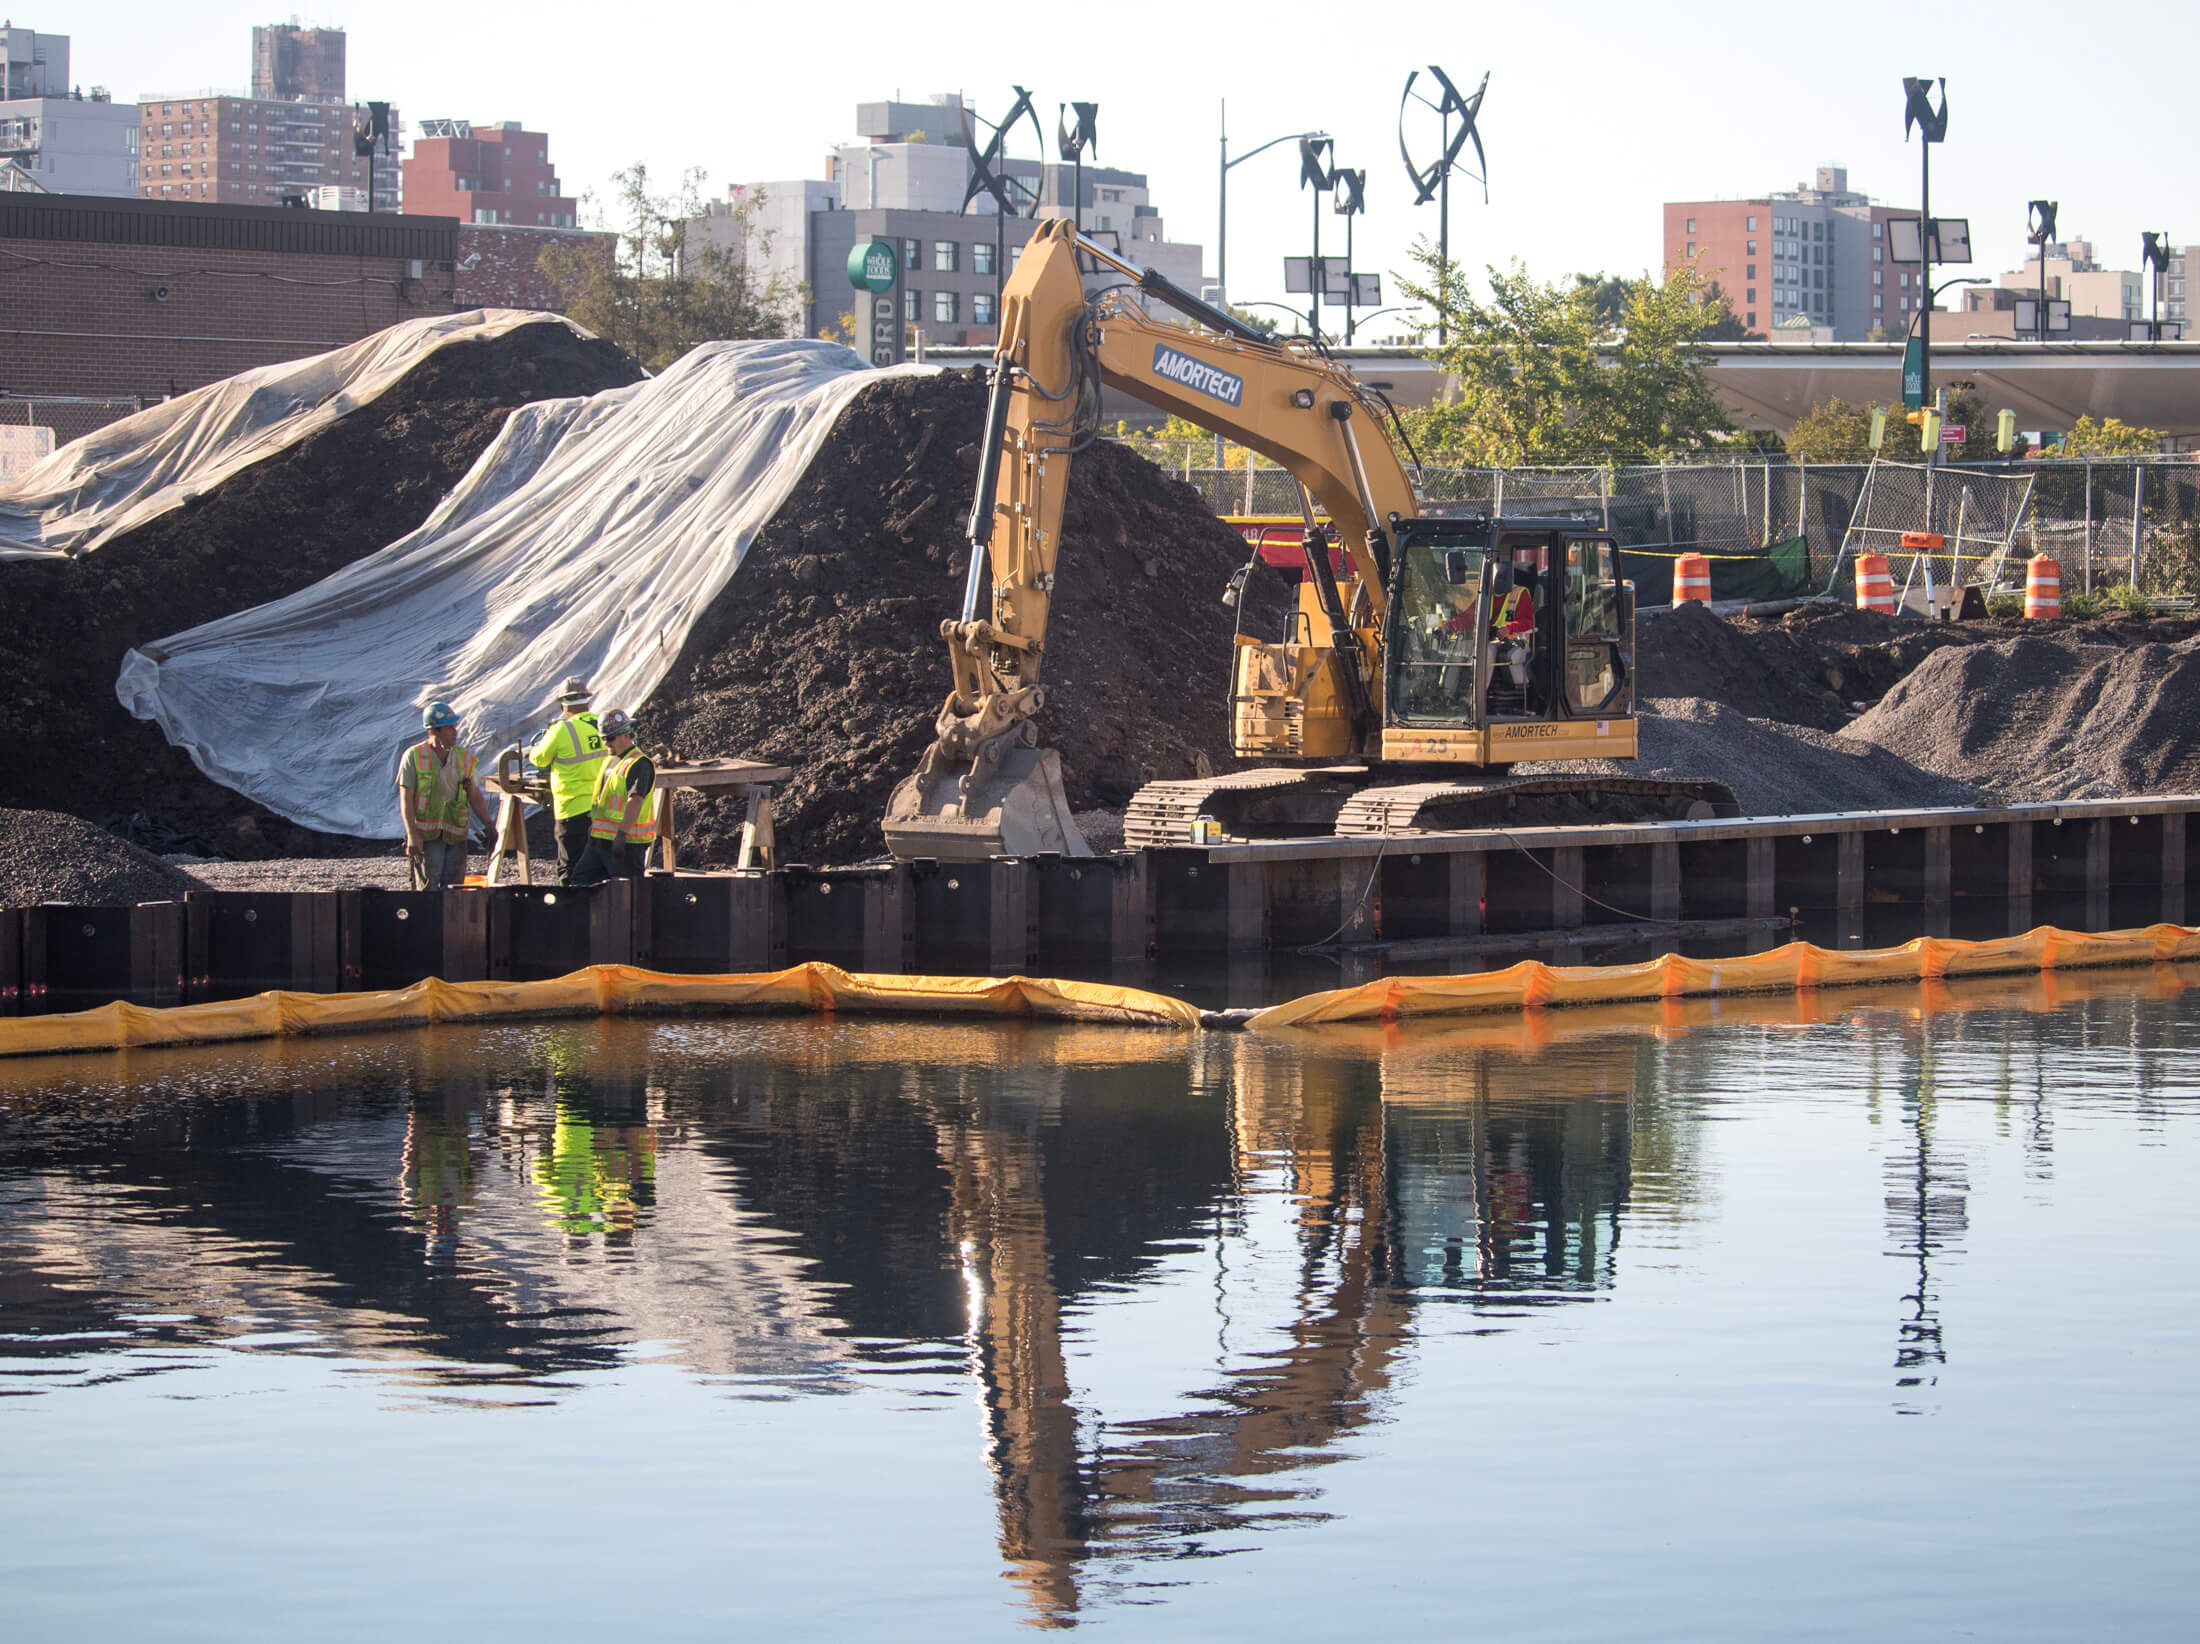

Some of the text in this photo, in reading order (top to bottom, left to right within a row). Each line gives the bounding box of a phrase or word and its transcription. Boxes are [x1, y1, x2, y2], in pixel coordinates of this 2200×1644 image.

[866, 253, 891, 264] WHOLE
[1154, 350, 1241, 402] AMORTECH
[1504, 724, 1559, 738] AMORTECH
[1427, 738, 1448, 753] 25
